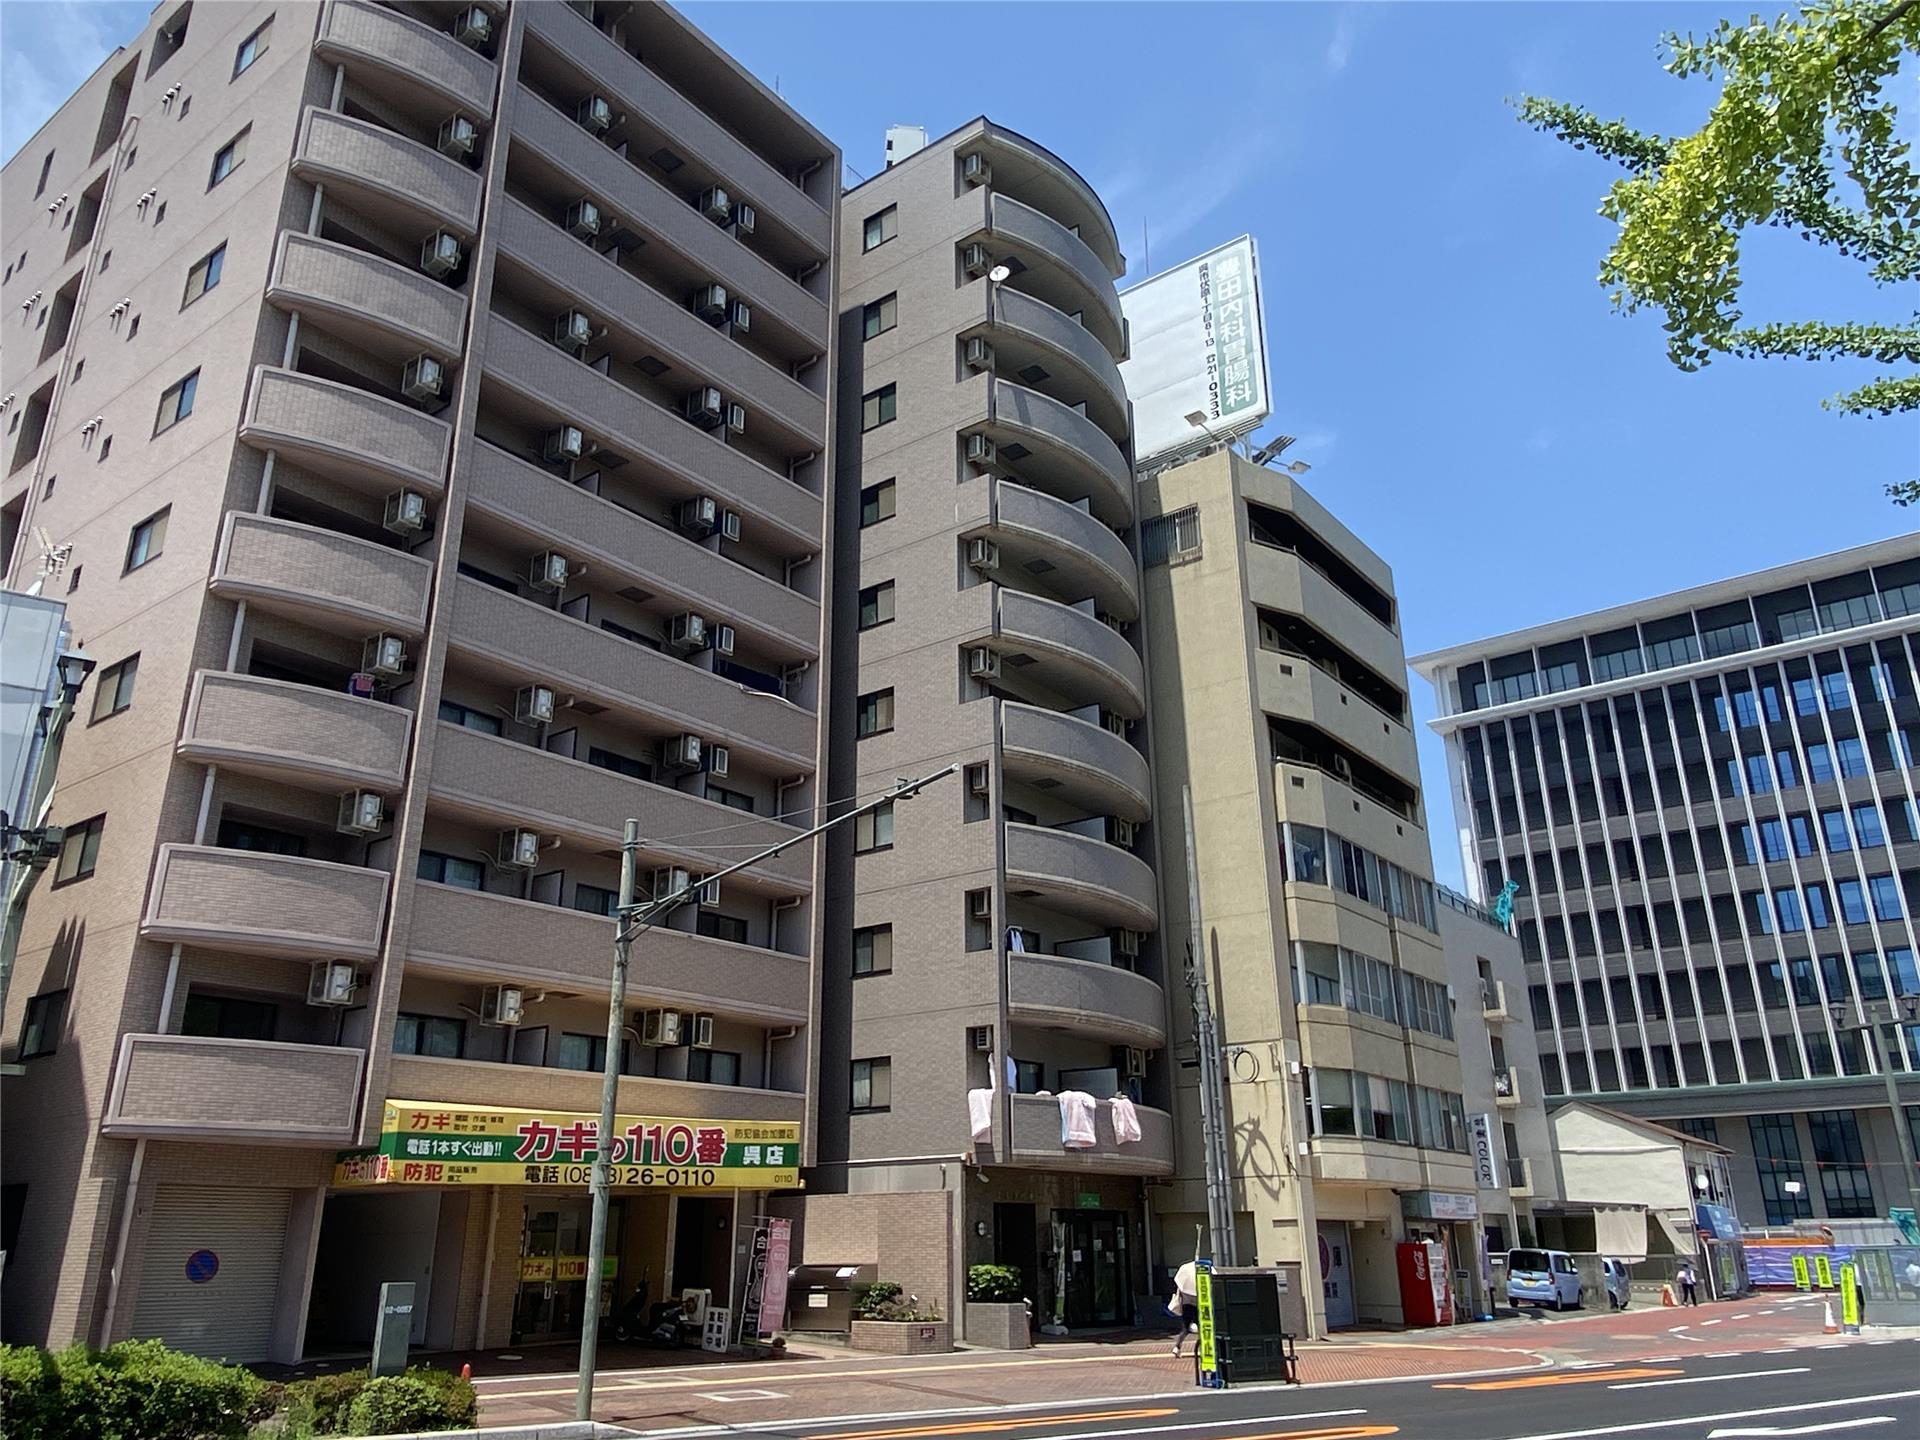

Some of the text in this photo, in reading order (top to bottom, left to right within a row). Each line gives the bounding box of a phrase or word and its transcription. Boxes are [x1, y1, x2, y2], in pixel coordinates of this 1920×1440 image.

[411, 1112, 450, 1131] カギ
[514, 1119, 726, 1166] カギの110番
[403, 1162, 444, 1182] 防犯
[525, 1165, 715, 1186] 電話 (083)26-0110
[774, 1174, 793, 1184] 0110
